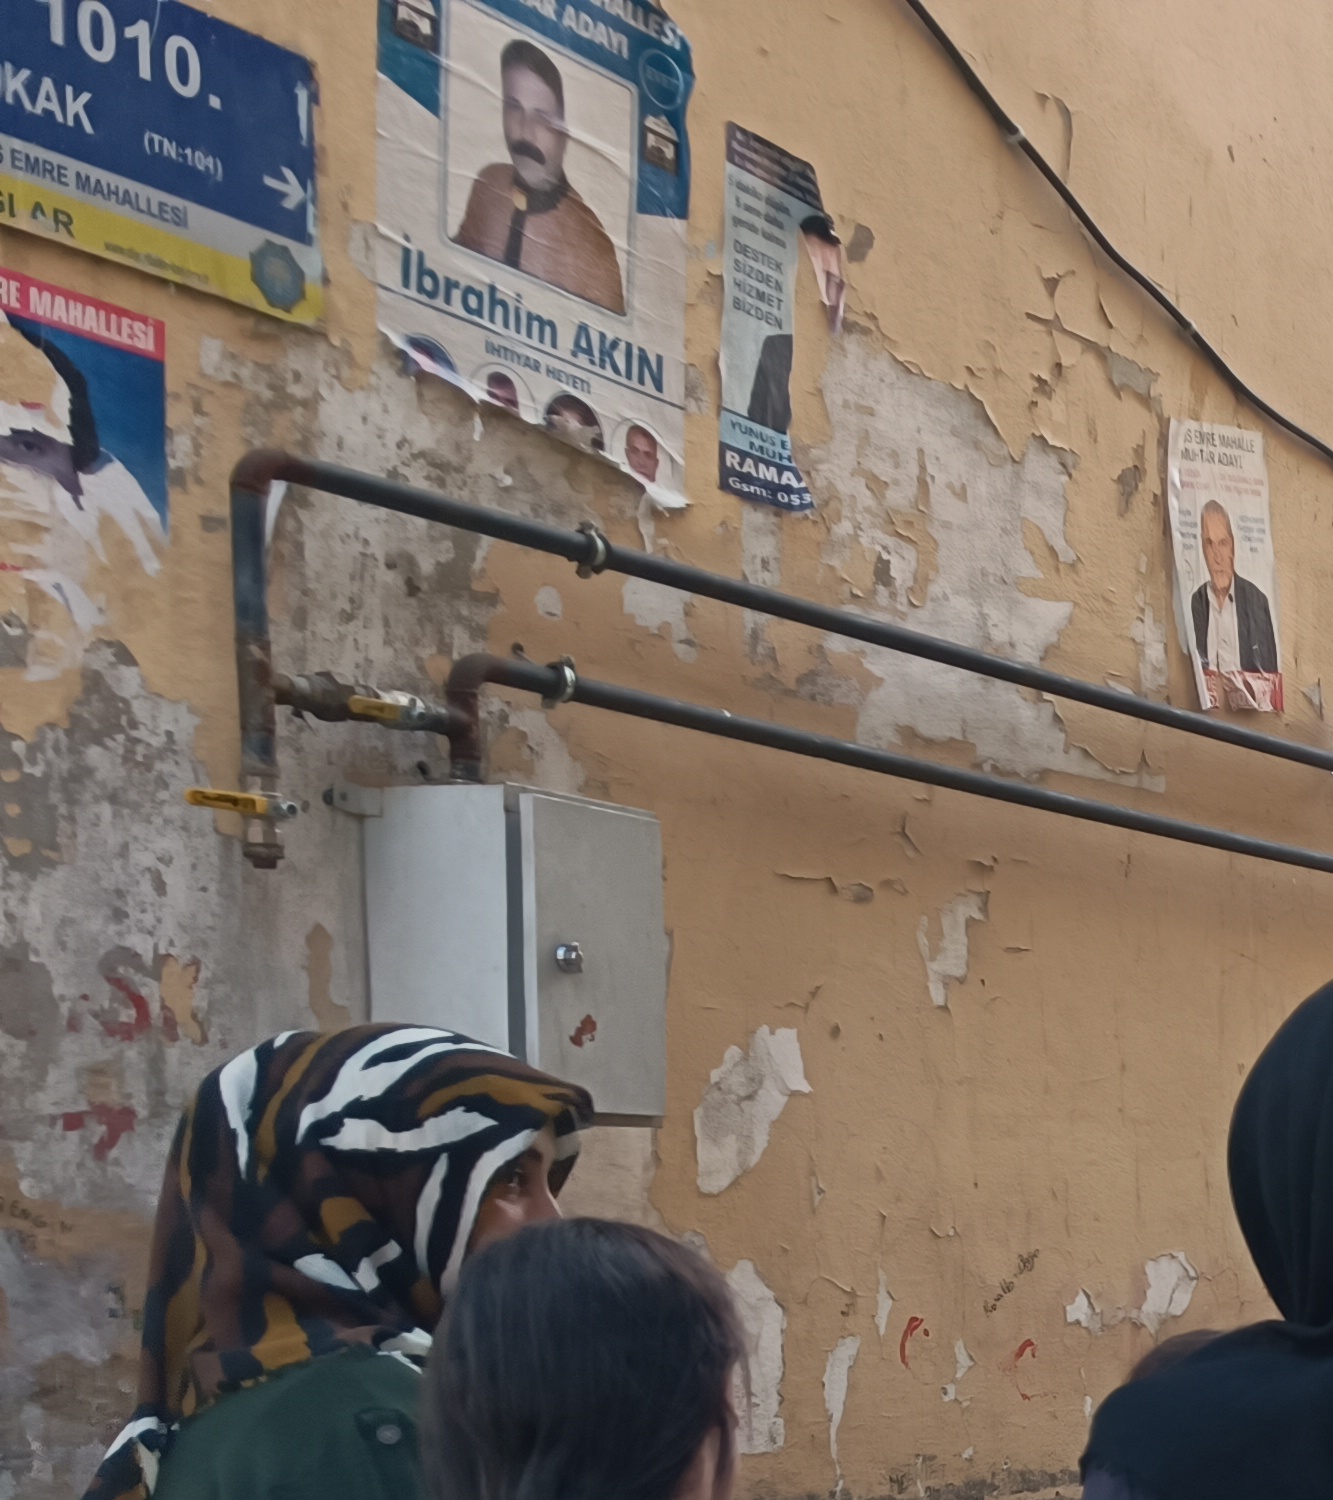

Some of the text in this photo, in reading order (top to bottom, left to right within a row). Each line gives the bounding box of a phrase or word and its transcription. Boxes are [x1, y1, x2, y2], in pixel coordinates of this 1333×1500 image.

[49, 0, 222, 110] 1010.
[0, 60, 95, 135] KAK
[10, 147, 70, 188] EMRE
[733, 239, 784, 276] DESTEK
[733, 258, 784, 294] SİZDEN
[733, 277, 784, 312] HİZMET
[29, 286, 156, 353] MAHALLESİ
[401, 233, 664, 394] İbrahim AKIN
[732, 296, 783, 330] BİZDEN
[730, 419, 776, 447] YUNUS
[749, 441, 793, 464] MUH
[728, 477, 773, 499] Gsm:
